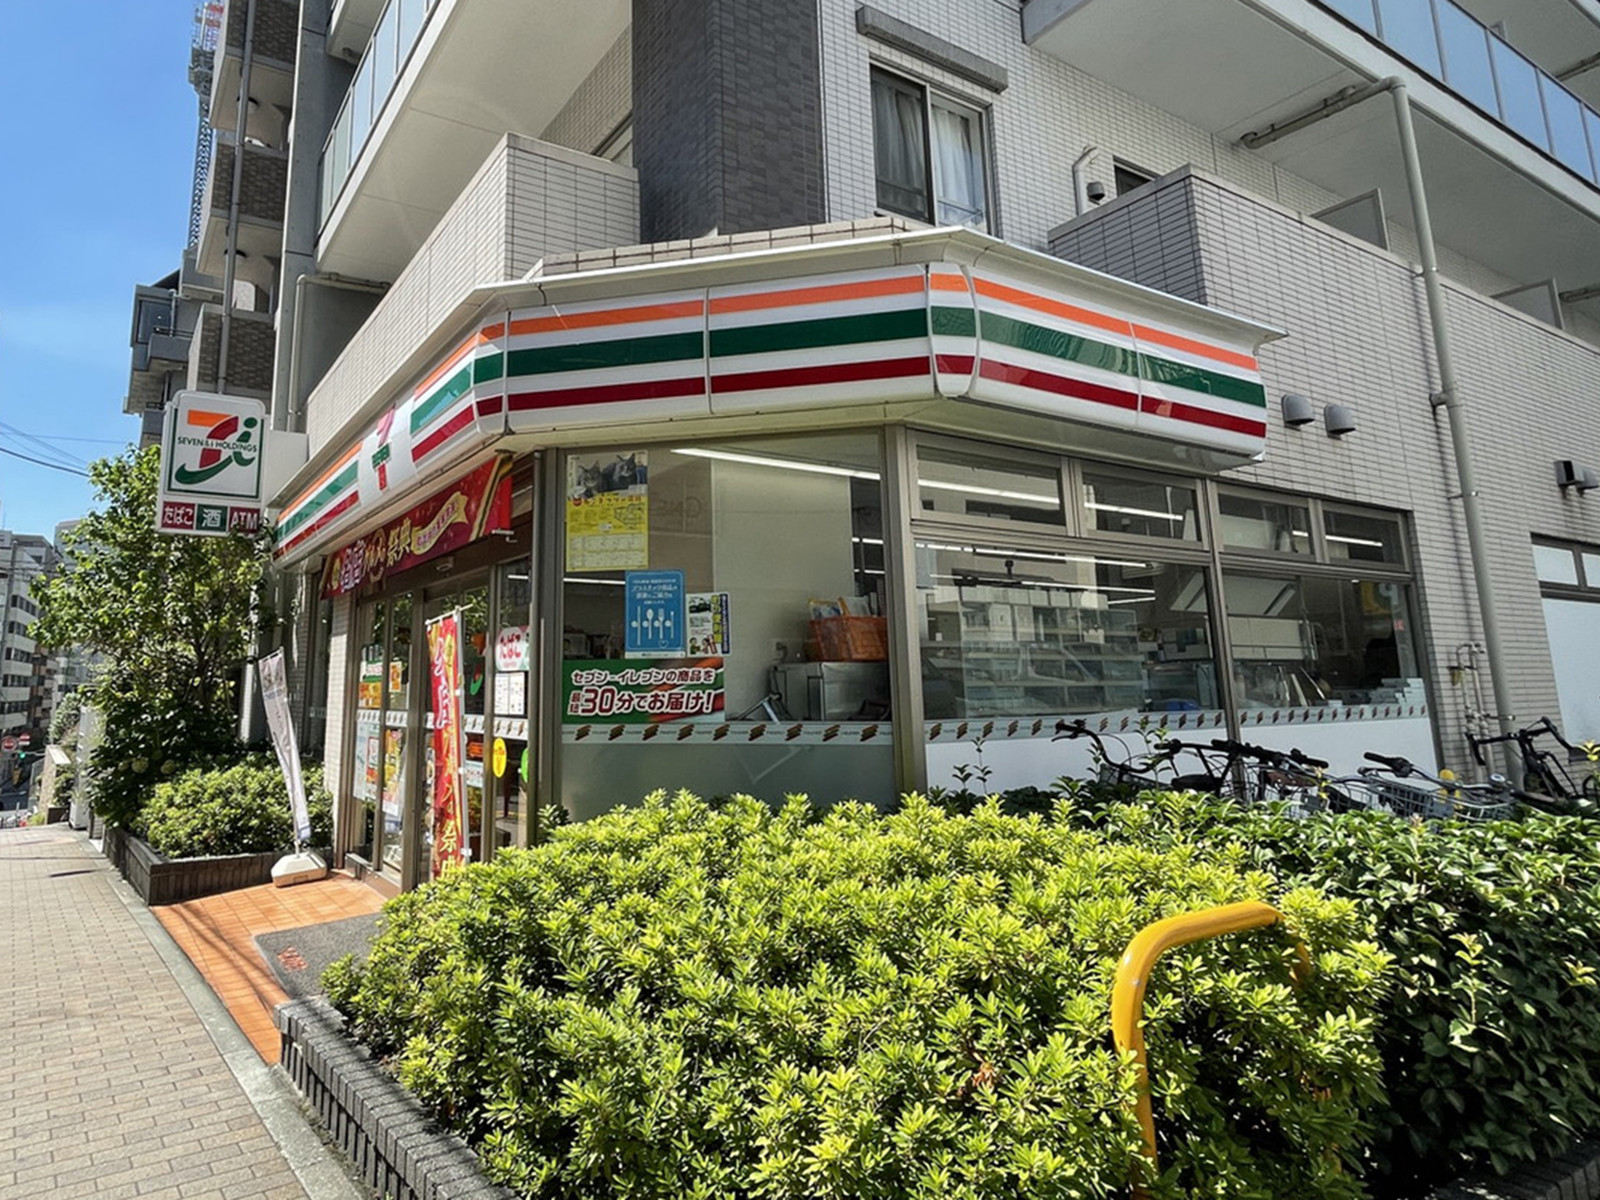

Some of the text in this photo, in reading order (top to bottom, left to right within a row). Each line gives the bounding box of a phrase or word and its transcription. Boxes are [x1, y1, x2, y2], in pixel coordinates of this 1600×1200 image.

[163, 506, 193, 525] たばこ
[202, 509, 222, 527] 酒
[230, 511, 258, 530] ATM
